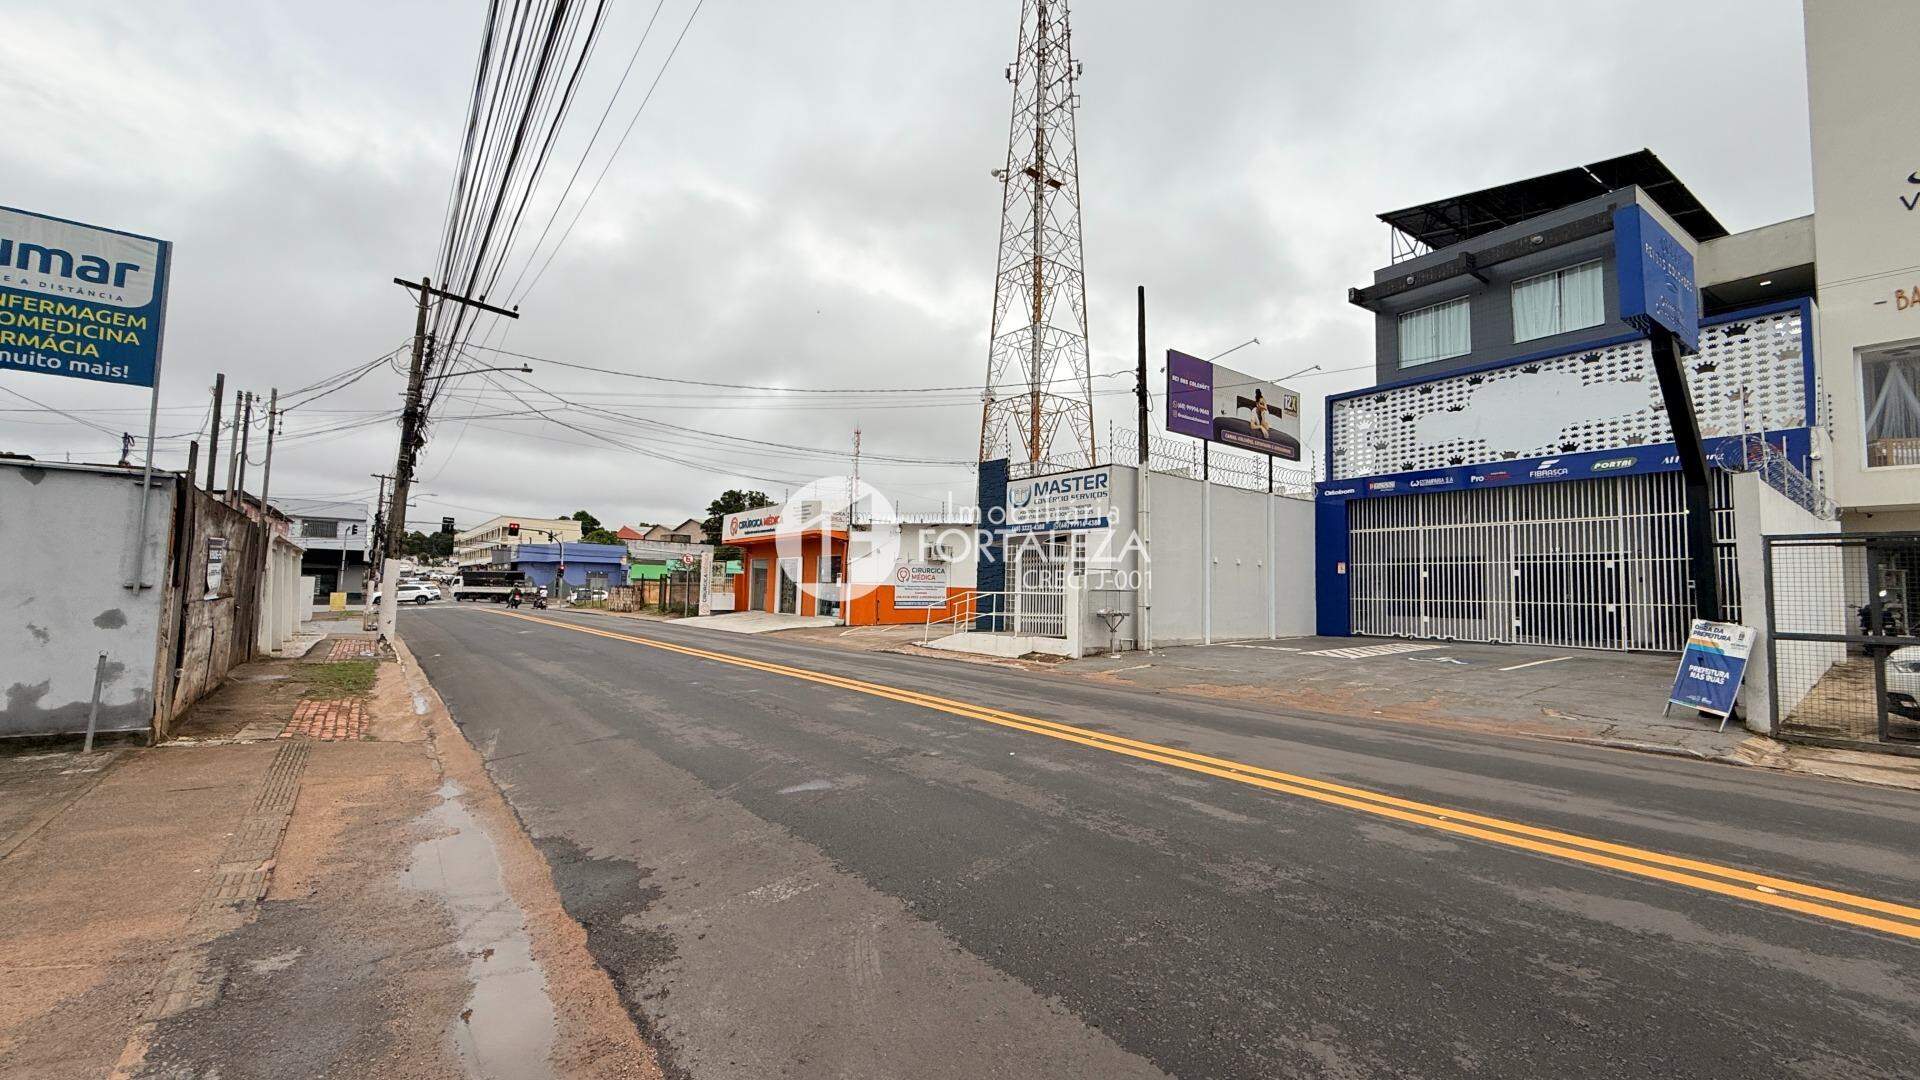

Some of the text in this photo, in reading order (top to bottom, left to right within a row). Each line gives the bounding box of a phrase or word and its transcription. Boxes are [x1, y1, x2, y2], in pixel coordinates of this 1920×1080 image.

[0, 239, 140, 288] mar
[39, 281, 124, 303] DISTÂNCIA
[69, 358, 129, 378] mais!
[1593, 459, 1633, 469] PORTAL
[1529, 468, 1568, 478] FIBRASCA
[1034, 473, 1108, 496] MASTER
[1070, 490, 1108, 501] SERVIÇOS
[1324, 488, 1355, 496] Ortobom
[911, 573, 936, 581] MÉDICA
[1693, 630, 1731, 641] PREFEITURA
[1688, 664, 1730, 679] PREFEITURA
[1689, 671, 1725, 685] NAS RUAS
